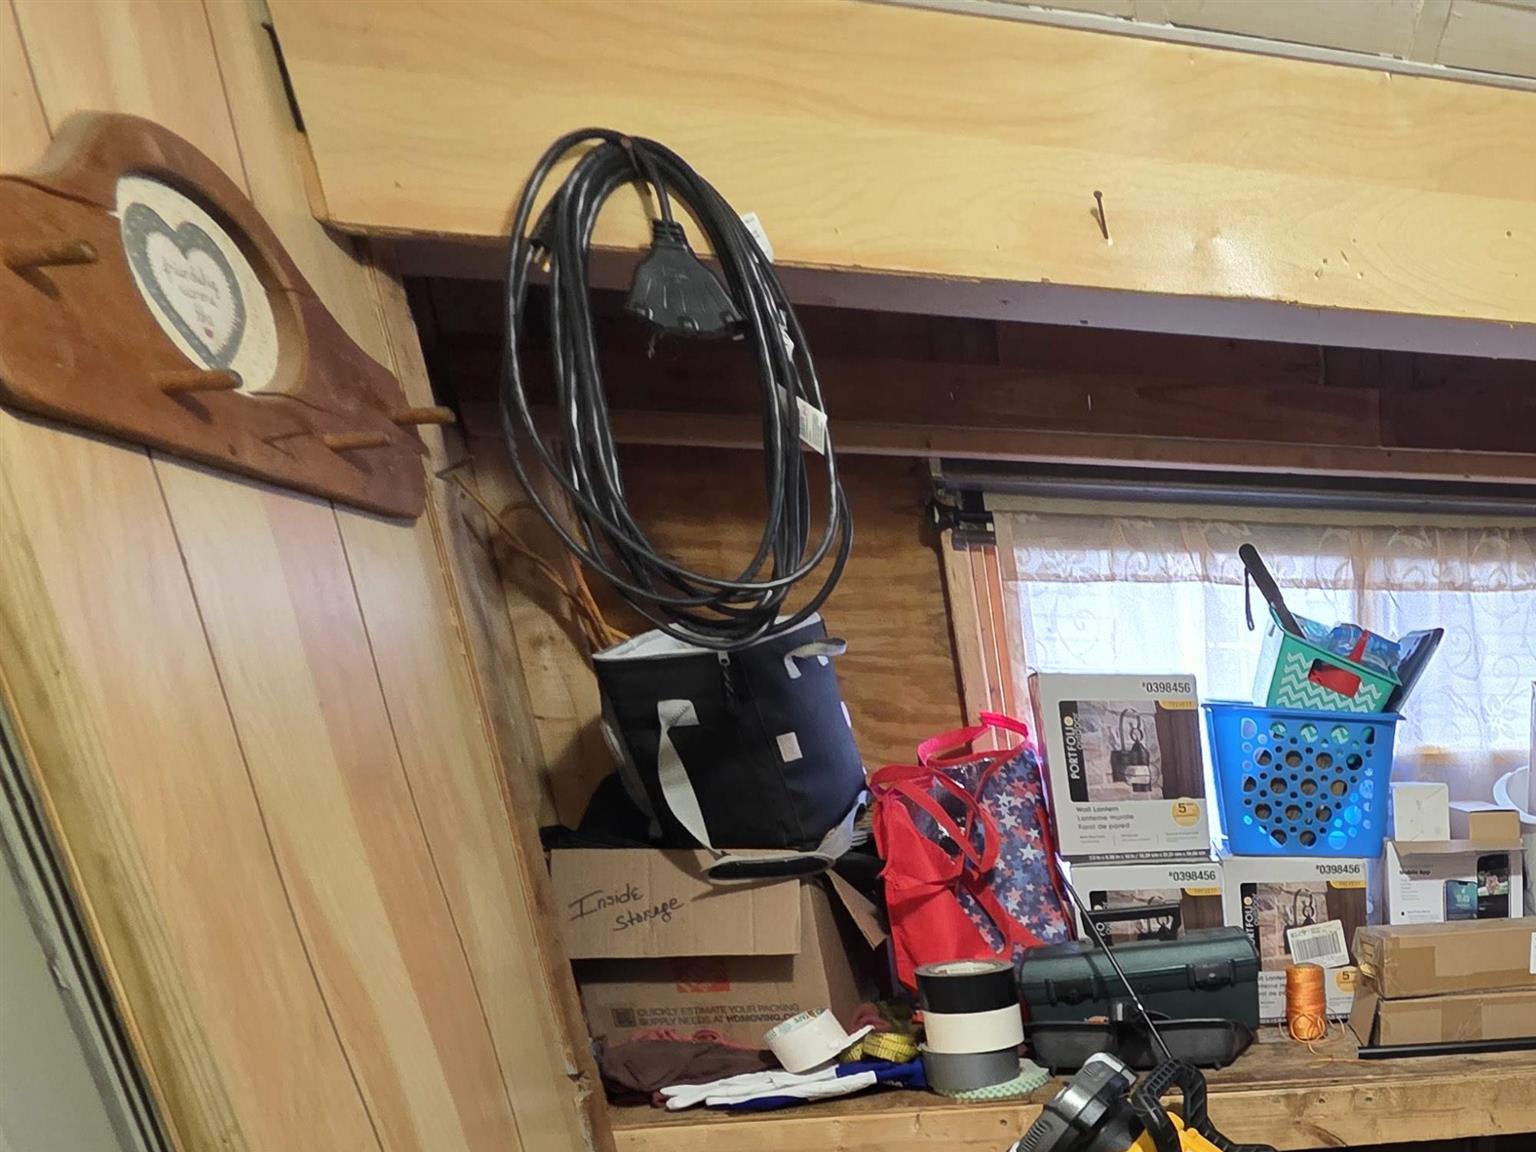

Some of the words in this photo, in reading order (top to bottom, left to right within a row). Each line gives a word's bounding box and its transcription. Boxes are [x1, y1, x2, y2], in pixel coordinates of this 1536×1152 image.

[1063, 715, 1080, 780] PORTFOLIO
[1178, 802, 1187, 813] 5
[567, 883, 644, 922] Inside
[612, 897, 685, 932] Storage
[1342, 970, 1350, 980] 5
[728, 1004, 757, 1014] YOUR
